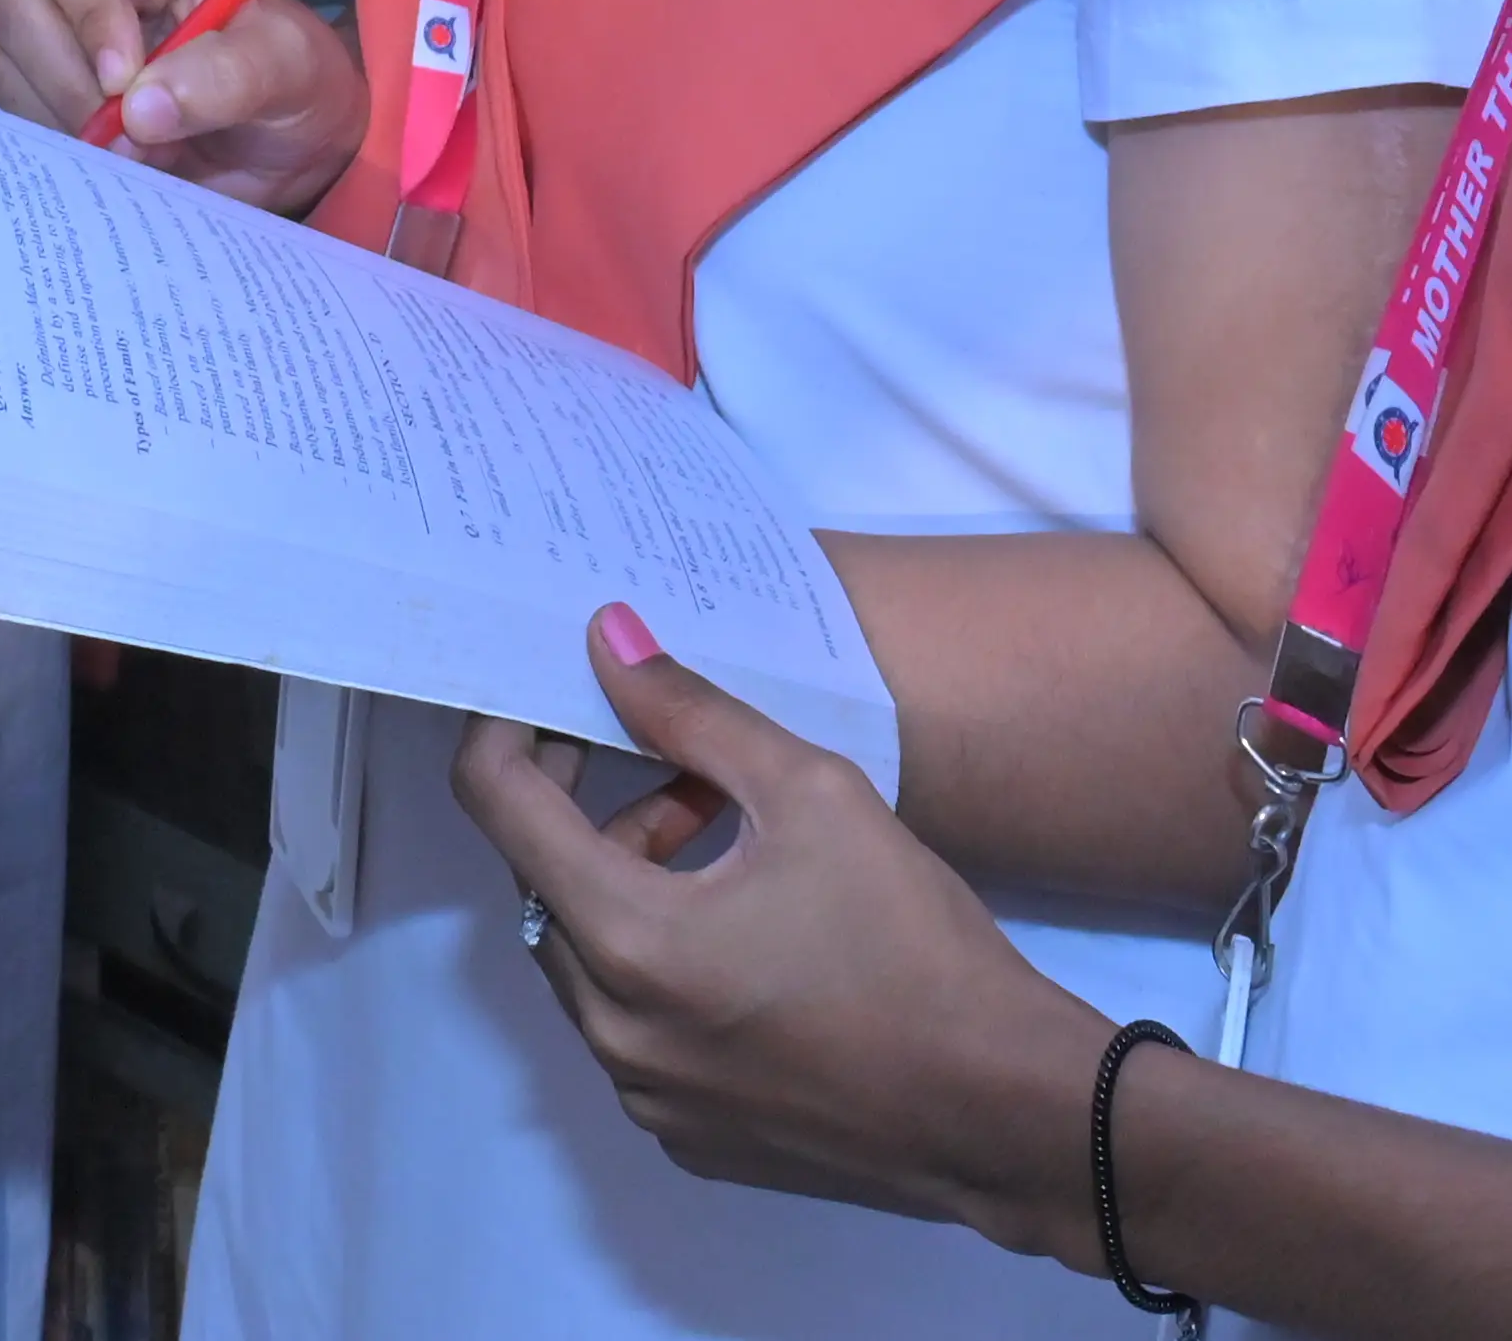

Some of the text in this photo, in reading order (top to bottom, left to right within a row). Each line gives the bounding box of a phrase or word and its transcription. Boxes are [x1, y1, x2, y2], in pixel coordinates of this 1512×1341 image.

[1410, 137, 1496, 370] MOTHER
[12, 359, 37, 430] Answer:
[52, 333, 76, 393] defined
[113, 327, 152, 456] Types of Family:
